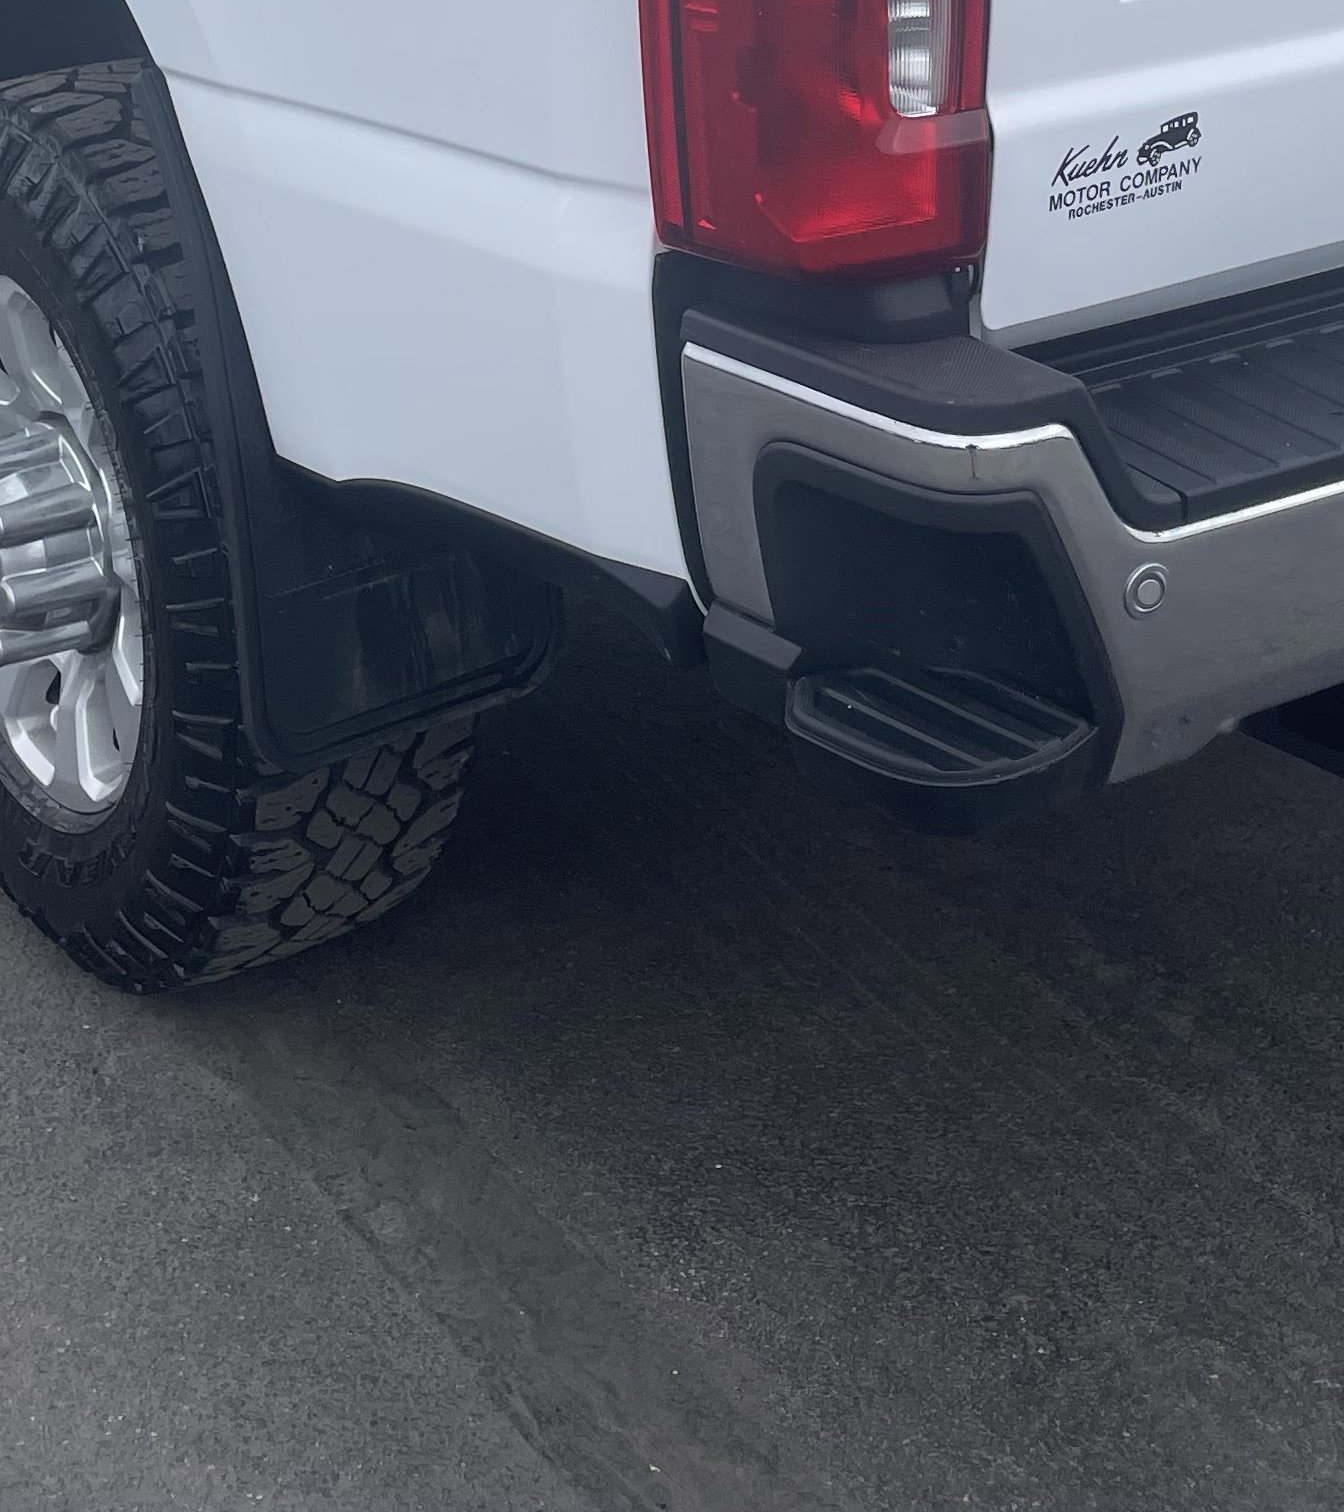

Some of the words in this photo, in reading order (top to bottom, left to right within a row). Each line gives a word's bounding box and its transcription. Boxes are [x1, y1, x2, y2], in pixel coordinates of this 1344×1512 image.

[1048, 180, 1112, 213] MOTOR
[1119, 156, 1203, 193] COMPANY
[1051, 135, 1129, 188] Kuehn
